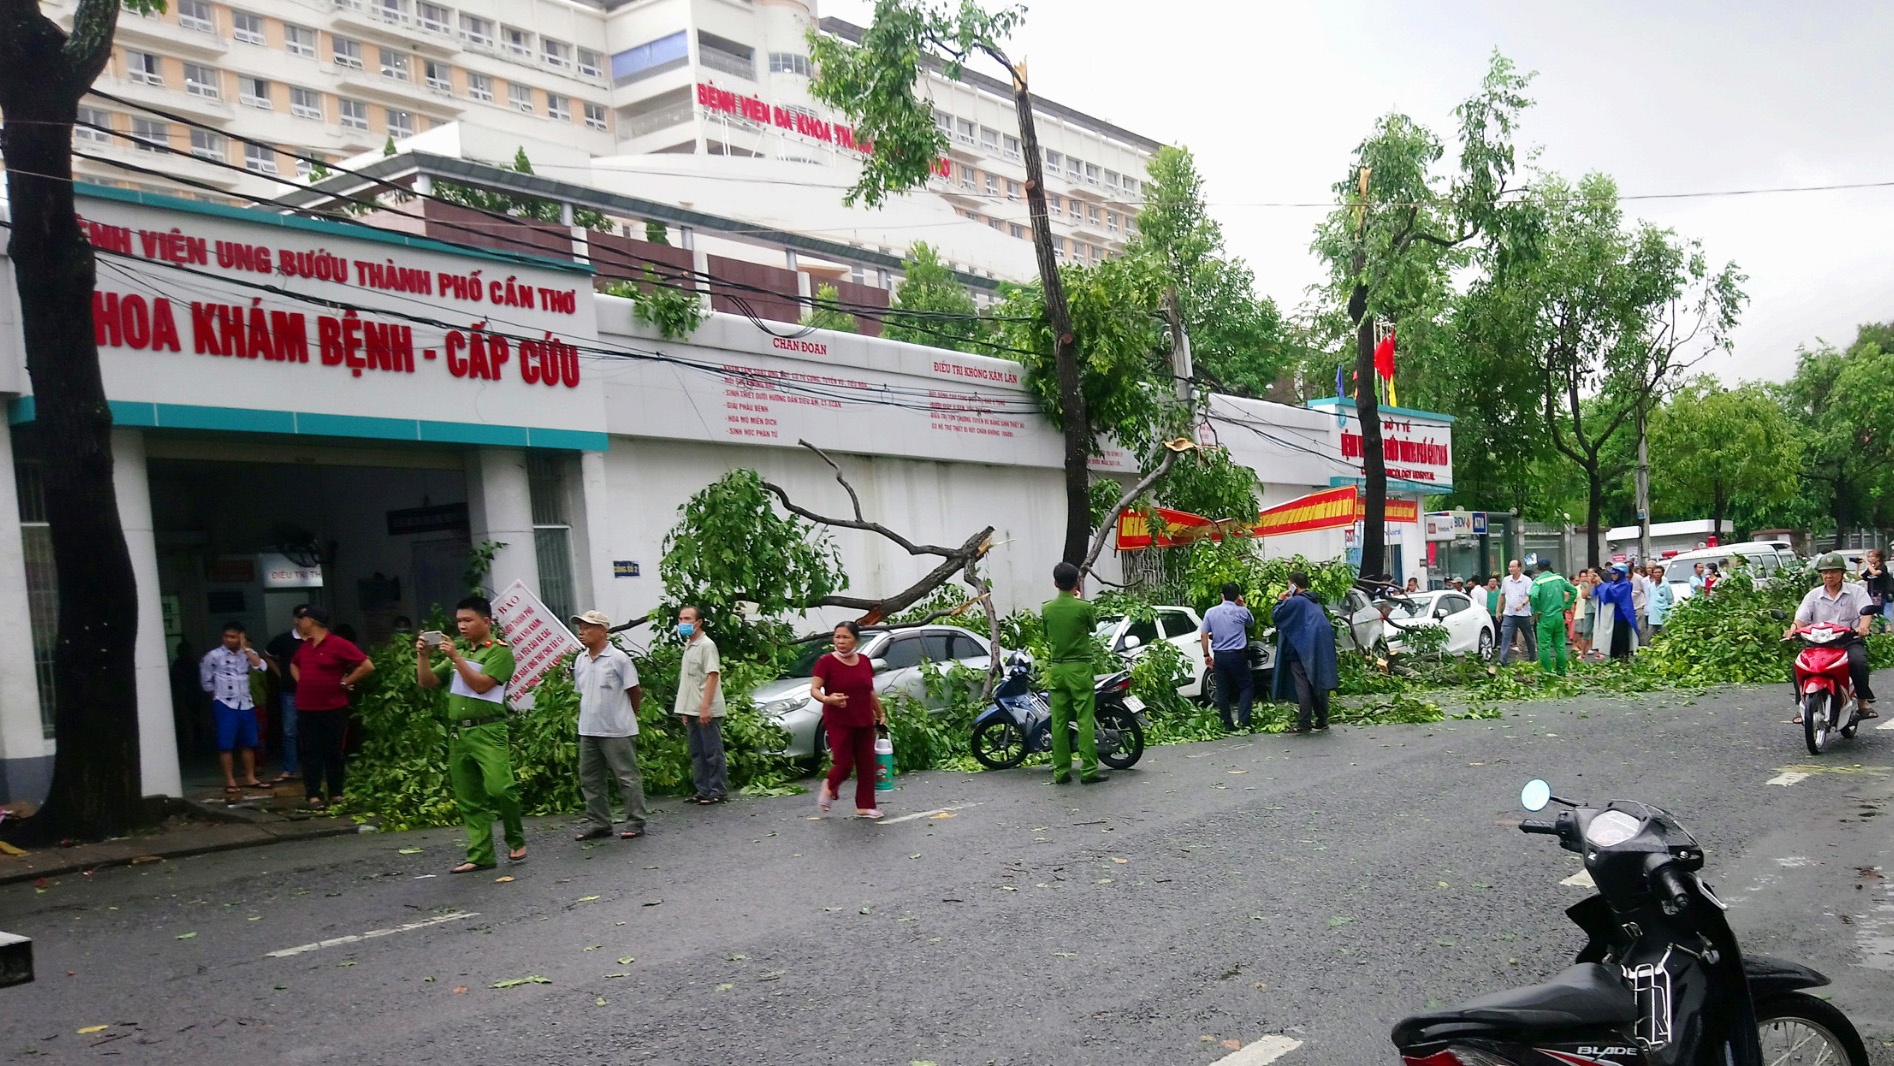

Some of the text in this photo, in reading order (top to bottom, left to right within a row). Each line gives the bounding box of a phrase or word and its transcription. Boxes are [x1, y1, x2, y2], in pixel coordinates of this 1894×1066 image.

[796, 113, 832, 143] KHOA
[138, 227, 207, 269] VIỆN
[215, 240, 273, 274] UNG
[279, 248, 348, 283] BƯỚU
[354, 259, 432, 295] THÀNH
[438, 270, 483, 302] PHỐ
[538, 287, 577, 315] THƠ
[92, 290, 181, 352] HOA
[191, 297, 309, 364] KHÁM
[318, 310, 414, 378] BỆNH
[445, 321, 509, 381] CẤP
[519, 331, 580, 387] CỨU
[1577, 1046, 1638, 1058] BLADE
